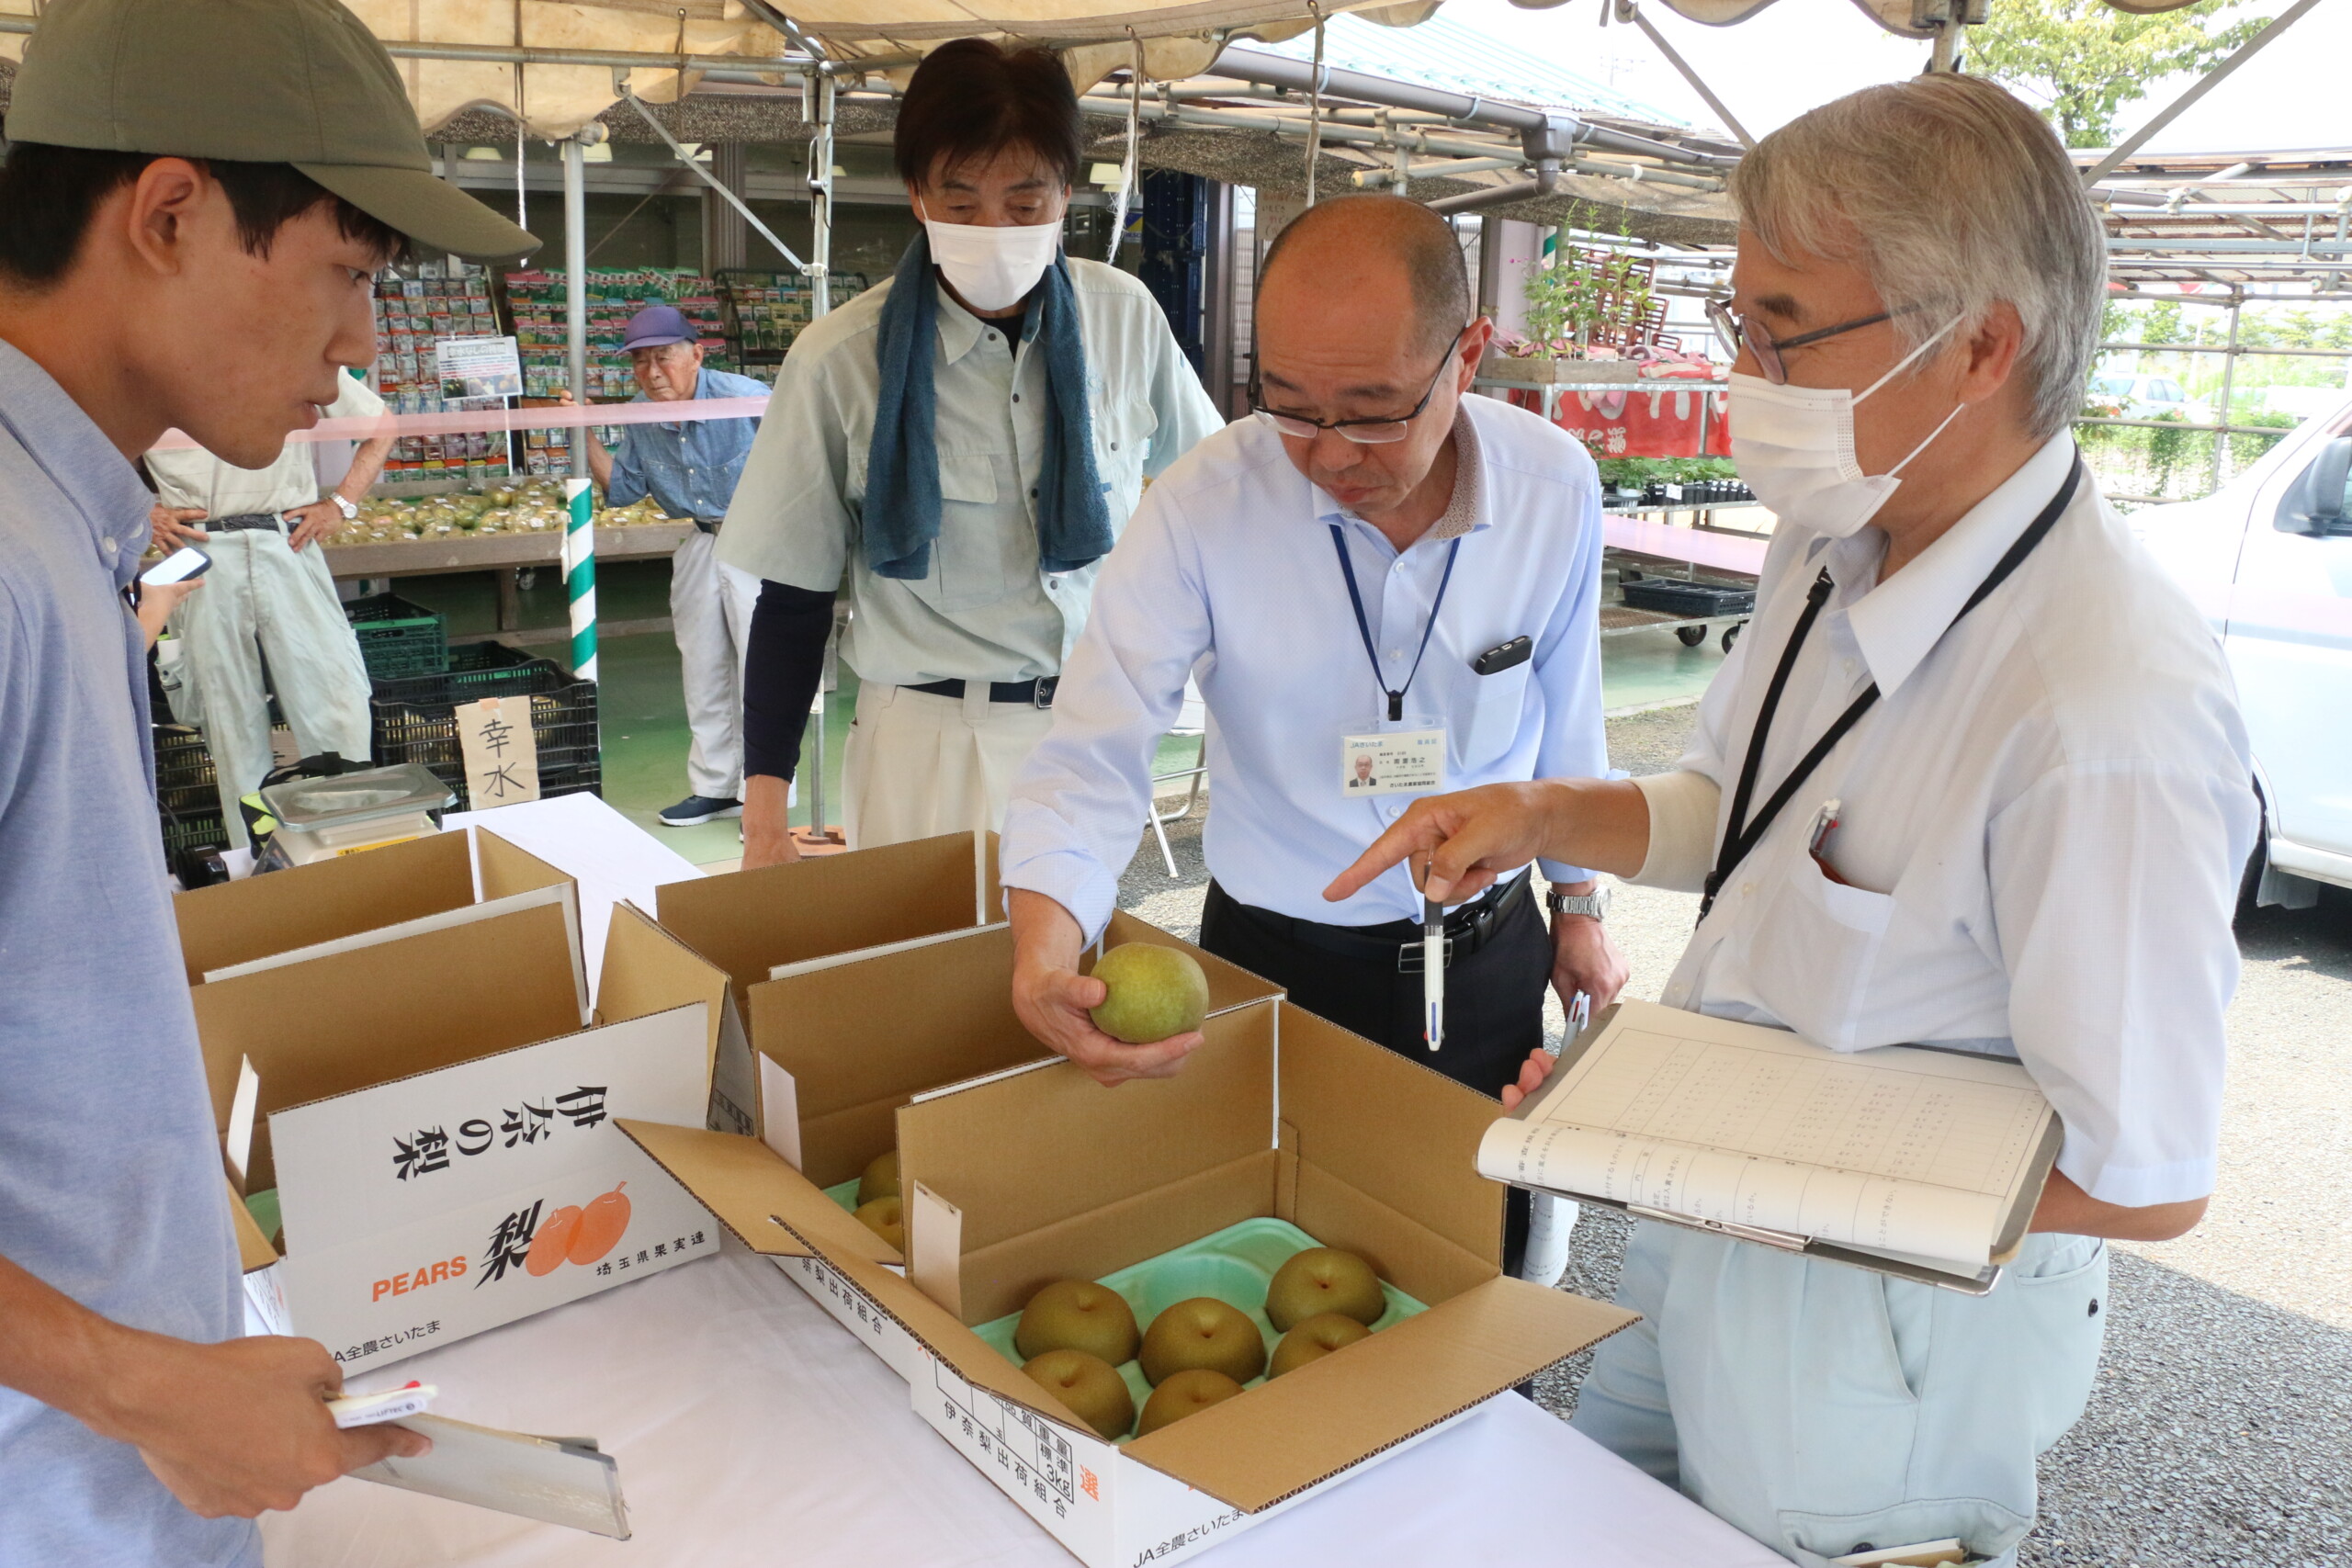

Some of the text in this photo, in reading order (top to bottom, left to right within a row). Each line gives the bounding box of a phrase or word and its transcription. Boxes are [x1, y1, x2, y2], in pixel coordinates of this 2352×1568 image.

[479, 717, 526, 798] 幸水
[392, 1085, 608, 1182] 伊奈の梨
[473, 1198, 544, 1292] 梨
[596, 1230, 706, 1276] 埼玉県果実連
[371, 1255, 467, 1303] PEARS
[332, 1319, 442, 1363] A全農さいたま
[944, 1400, 1067, 1519] 伊奈梨出荷組合
[1046, 1463, 1071, 1498] 3kg
